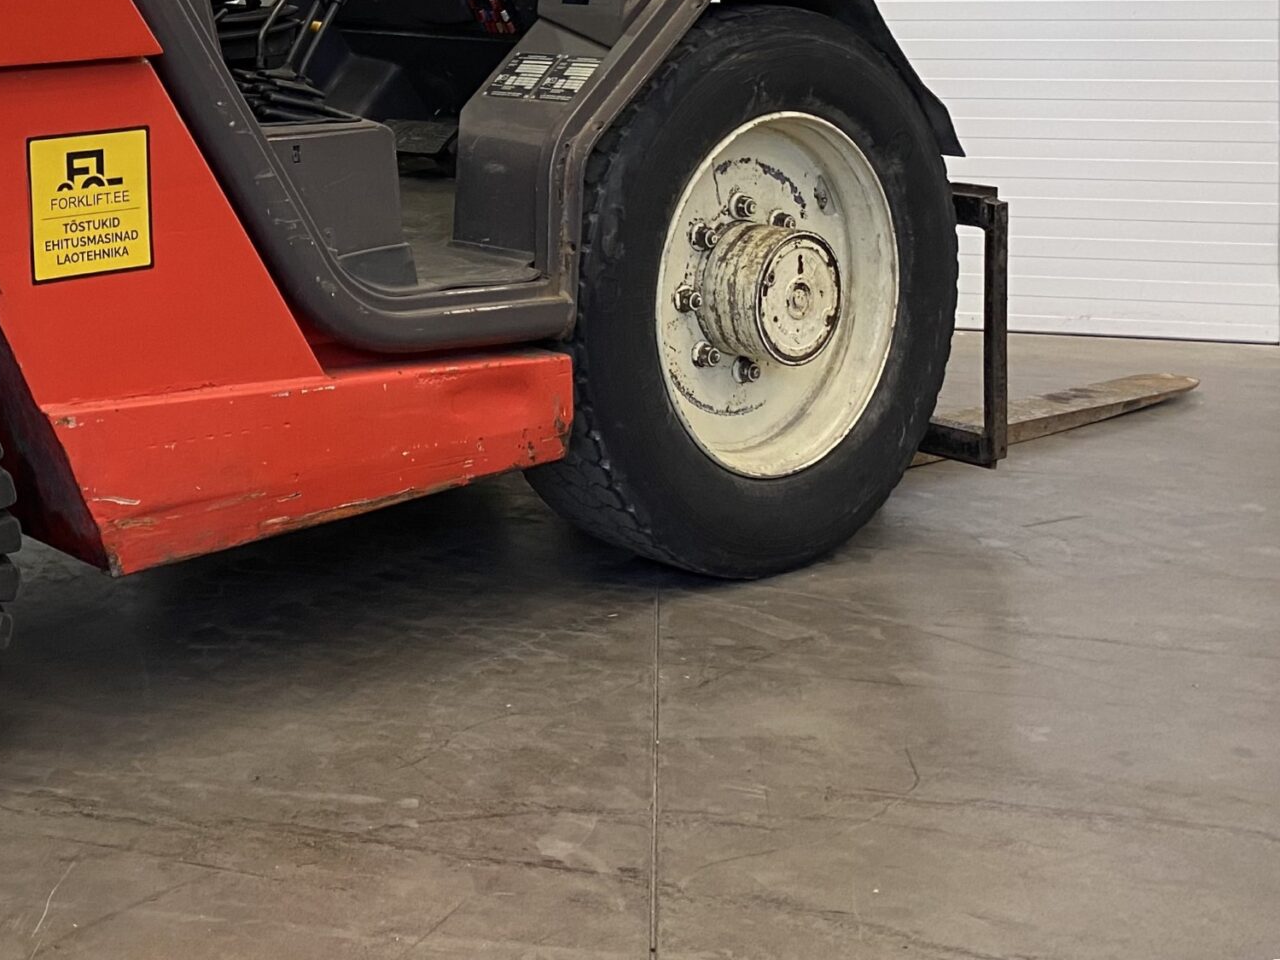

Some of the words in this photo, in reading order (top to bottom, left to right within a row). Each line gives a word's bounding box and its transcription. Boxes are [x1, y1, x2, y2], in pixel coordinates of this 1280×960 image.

[50, 190, 130, 211] FORKLIFT.EE
[62, 217, 120, 234] TÕSTUKID
[45, 230, 138, 252] EHITUSMASINAD
[56, 246, 129, 265] LAOTEHNIKA
